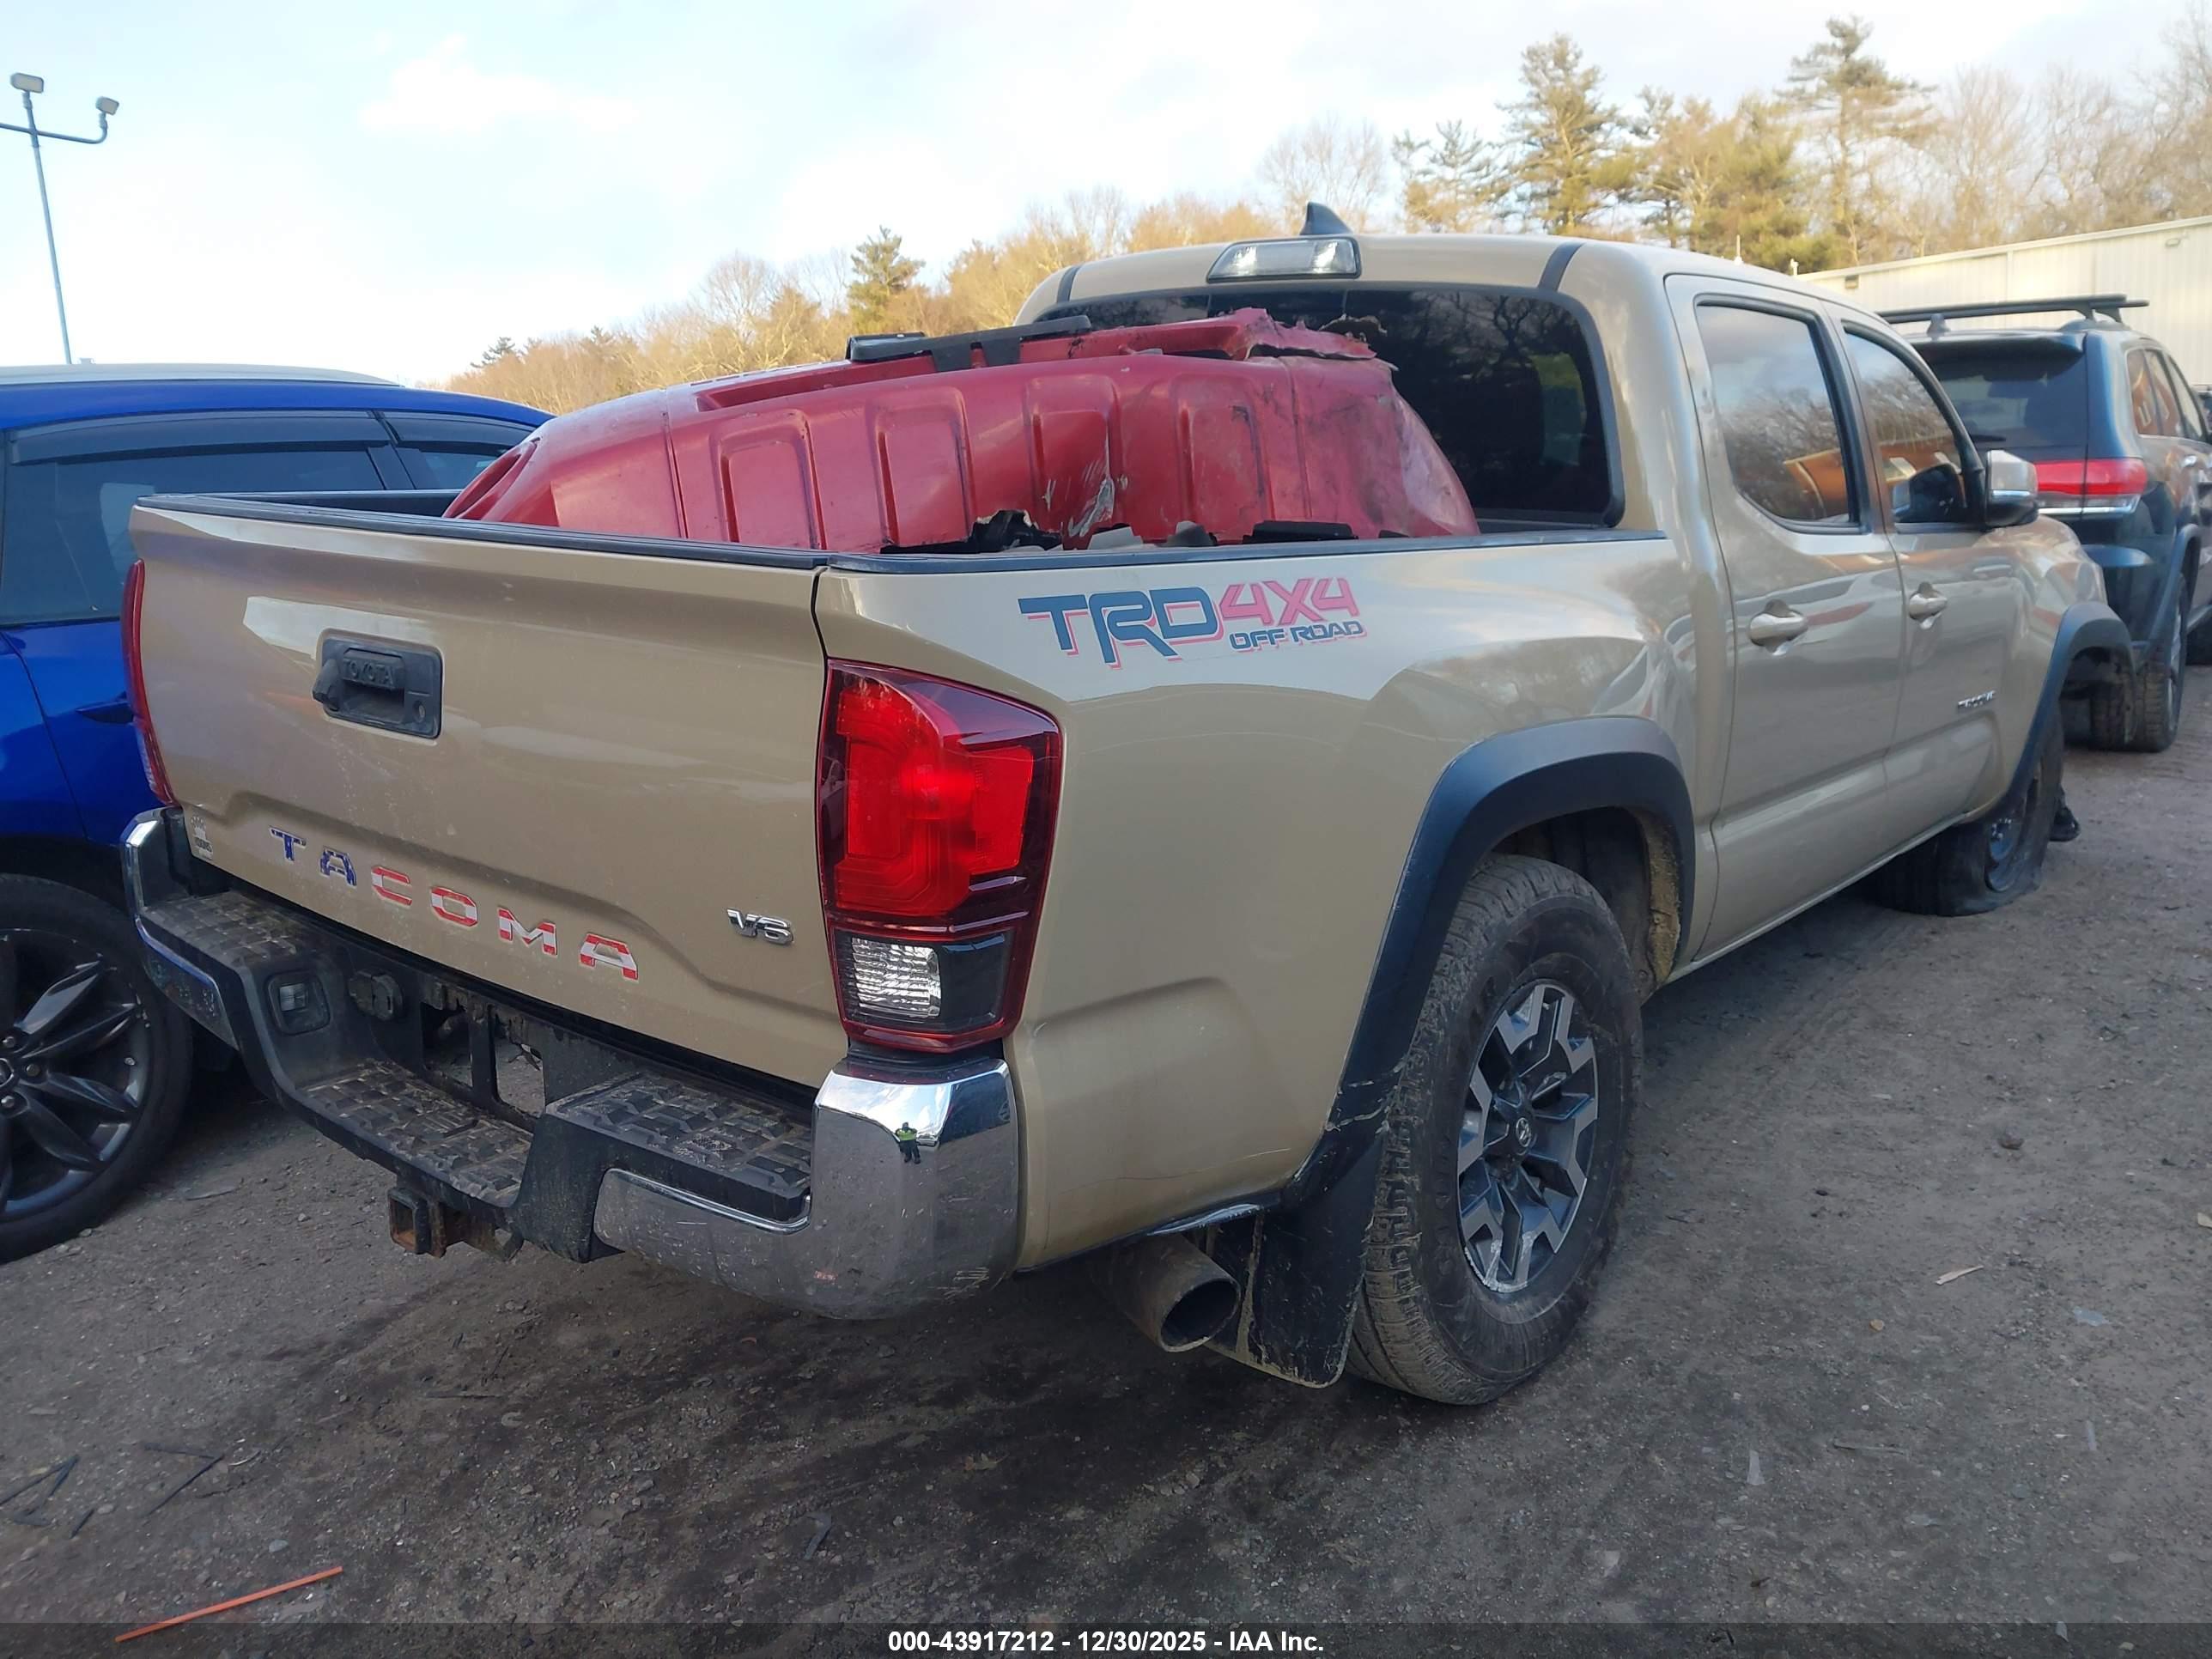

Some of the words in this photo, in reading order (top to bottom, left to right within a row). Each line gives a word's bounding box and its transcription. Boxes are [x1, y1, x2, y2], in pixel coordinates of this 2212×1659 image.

[1018, 587, 1224, 667] TRD
[1219, 578, 1360, 625] 4X4
[1230, 629, 1288, 652] OFF
[1291, 621, 1367, 646] ROAD
[342, 659, 394, 685] TOYOTA
[269, 826, 639, 981] TACOMA
[726, 908, 795, 945] V6
